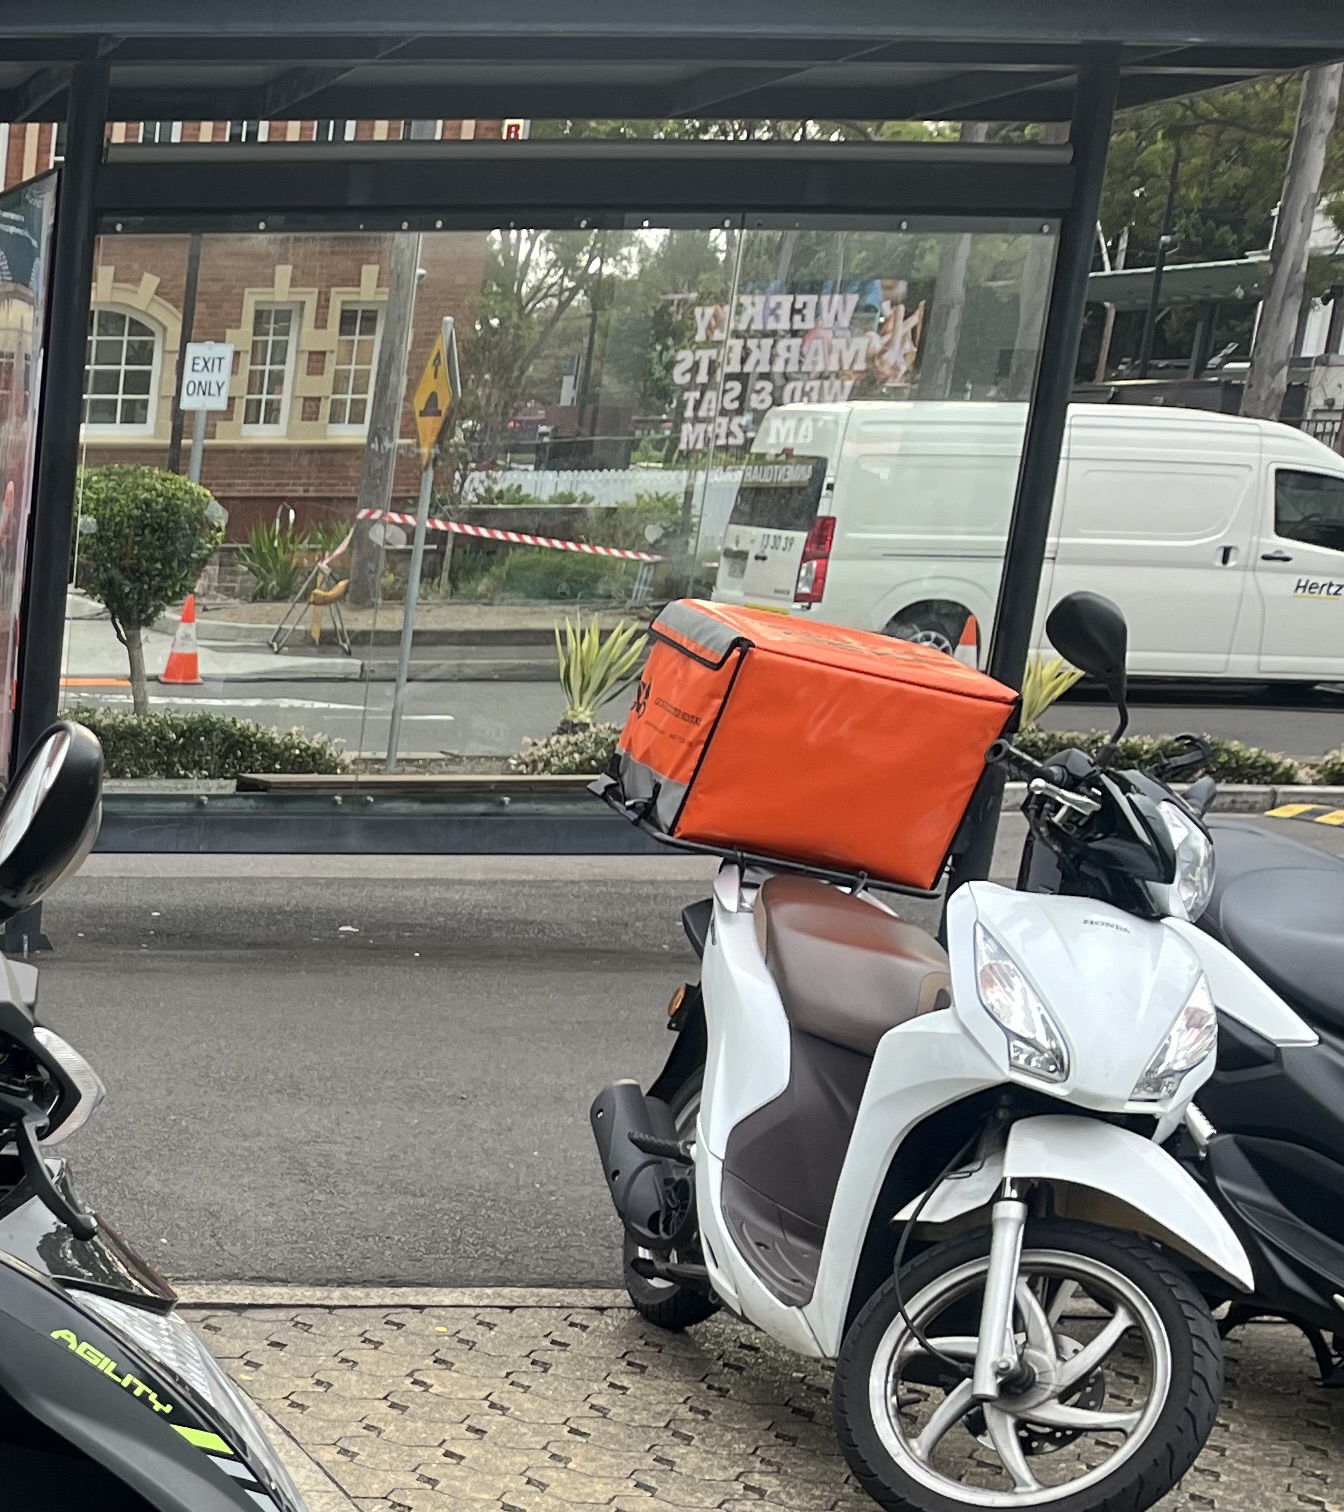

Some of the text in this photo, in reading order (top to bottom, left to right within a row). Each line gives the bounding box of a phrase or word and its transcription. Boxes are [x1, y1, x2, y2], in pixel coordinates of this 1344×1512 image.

[192, 356, 225, 373] EXIT
[186, 380, 225, 397] ONLY
[1293, 578, 1344, 596] Hertz
[1083, 919, 1132, 934] HONDA
[50, 1329, 173, 1413] AGILITY
